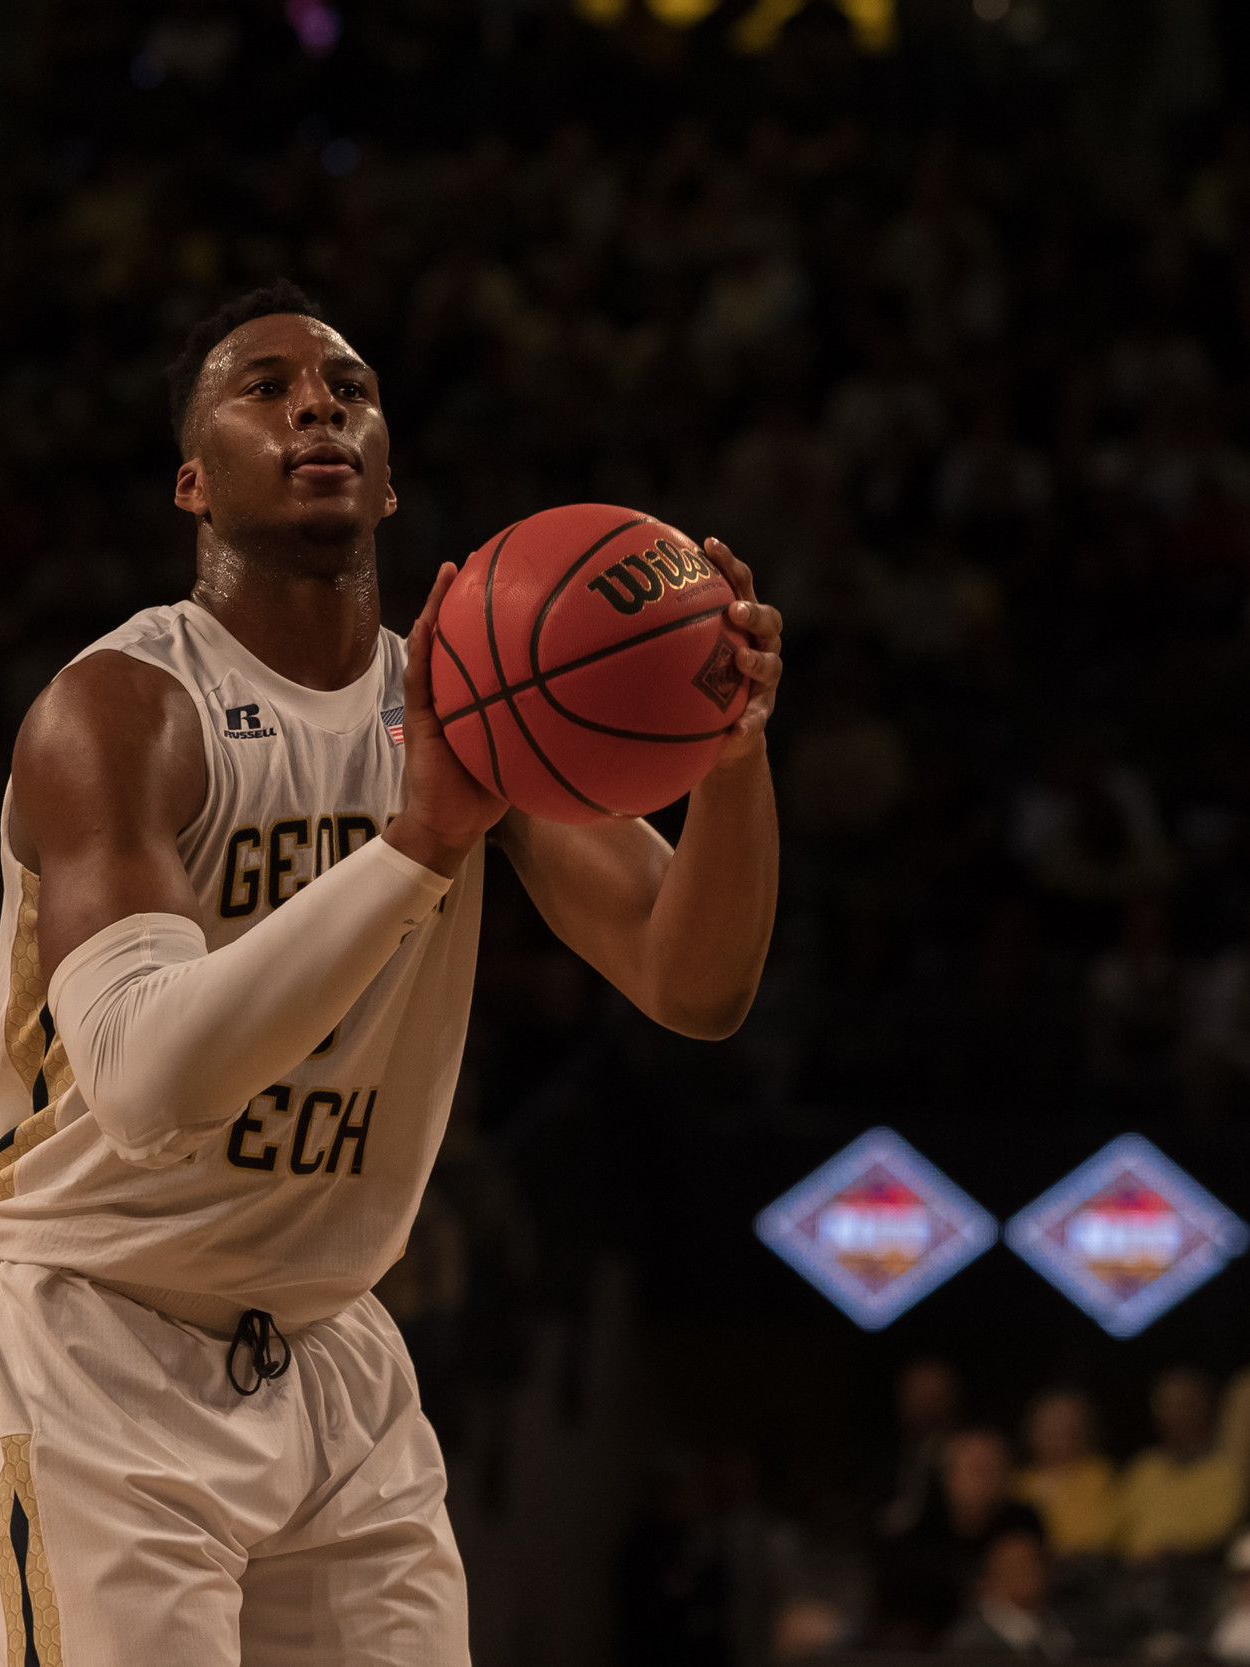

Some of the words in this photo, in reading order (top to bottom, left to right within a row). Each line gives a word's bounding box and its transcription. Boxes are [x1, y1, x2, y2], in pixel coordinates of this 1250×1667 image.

[587, 538, 721, 616] Wils
[223, 727, 277, 740] RUSSELL
[224, 1080, 381, 1178] ECH
